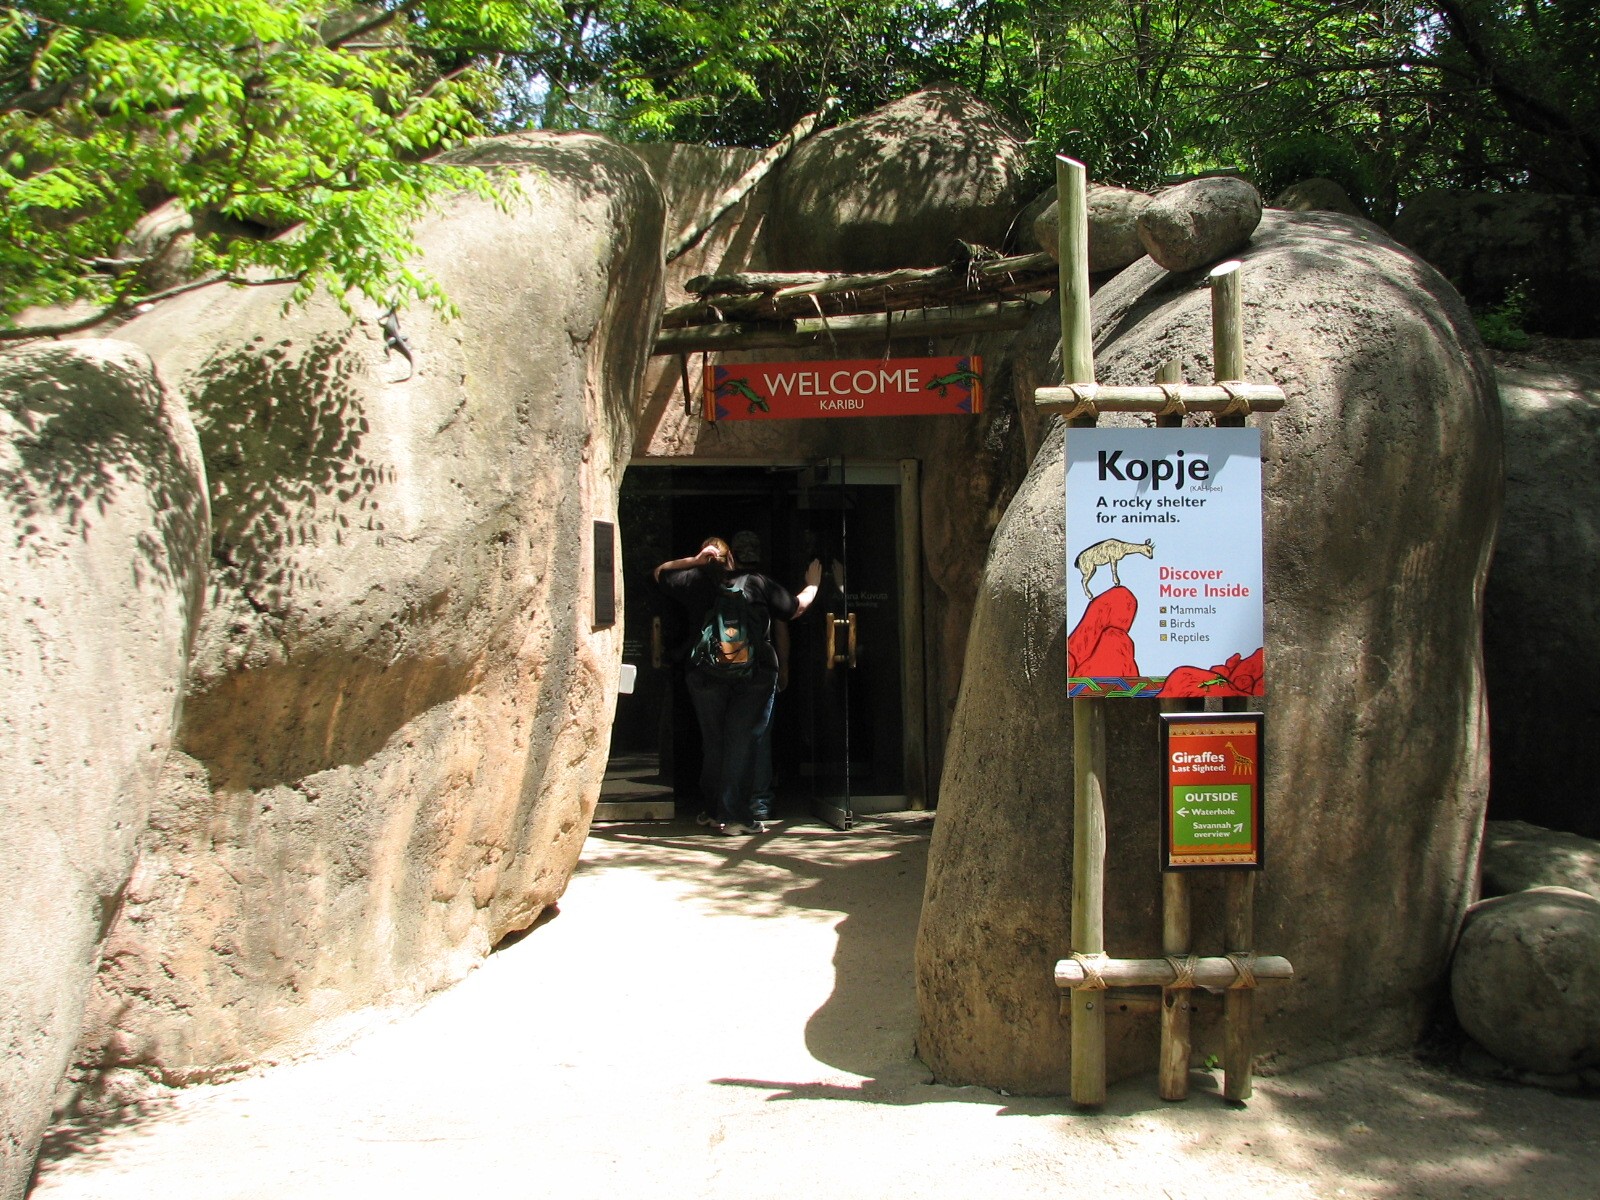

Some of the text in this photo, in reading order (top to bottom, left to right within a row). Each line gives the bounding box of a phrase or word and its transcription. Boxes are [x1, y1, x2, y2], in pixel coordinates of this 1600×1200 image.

[763, 368, 920, 397] WELCOME
[819, 399, 865, 410] KARIBU
[1098, 450, 1210, 490] Kopje
[1096, 496, 1207, 511] A rocky shelter
[1096, 511, 1180, 523] for animals.
[1159, 566, 1223, 580] Discover
[1159, 583, 1250, 598] More Inside
[1170, 605, 1217, 615] Mammals
[1170, 618, 1196, 628] Birds
[1170, 632, 1210, 644] Reptiles
[1172, 751, 1225, 763] Giraffes
[1192, 764, 1227, 773] Sighted:
[1185, 792, 1239, 802] OUTSIDE
[1191, 808, 1236, 816] Waterhole
[1193, 822, 1232, 830] Savannah
